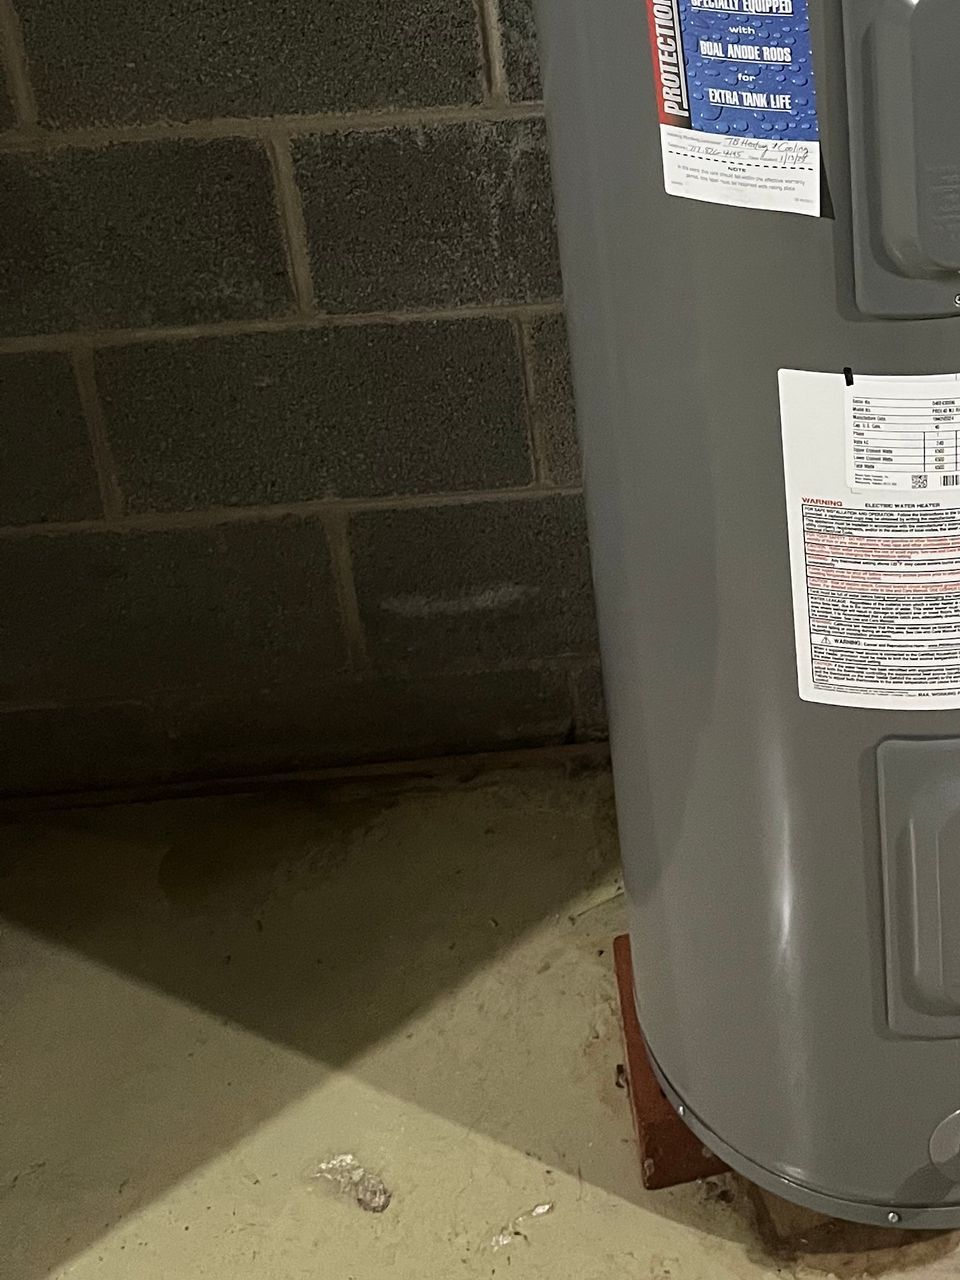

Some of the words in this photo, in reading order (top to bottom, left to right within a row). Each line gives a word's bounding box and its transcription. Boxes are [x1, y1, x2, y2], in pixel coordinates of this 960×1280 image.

[729, 25, 755, 35] with
[700, 41, 725, 58] DUAL
[728, 44, 760, 60] ANODE
[762, 46, 791, 62] RODS
[738, 73, 755, 82] for
[709, 88, 739, 106] EXTRA
[741, 91, 768, 108] TANK
[770, 93, 791, 109] LIFE
[801, 497, 843, 507] WARNING
